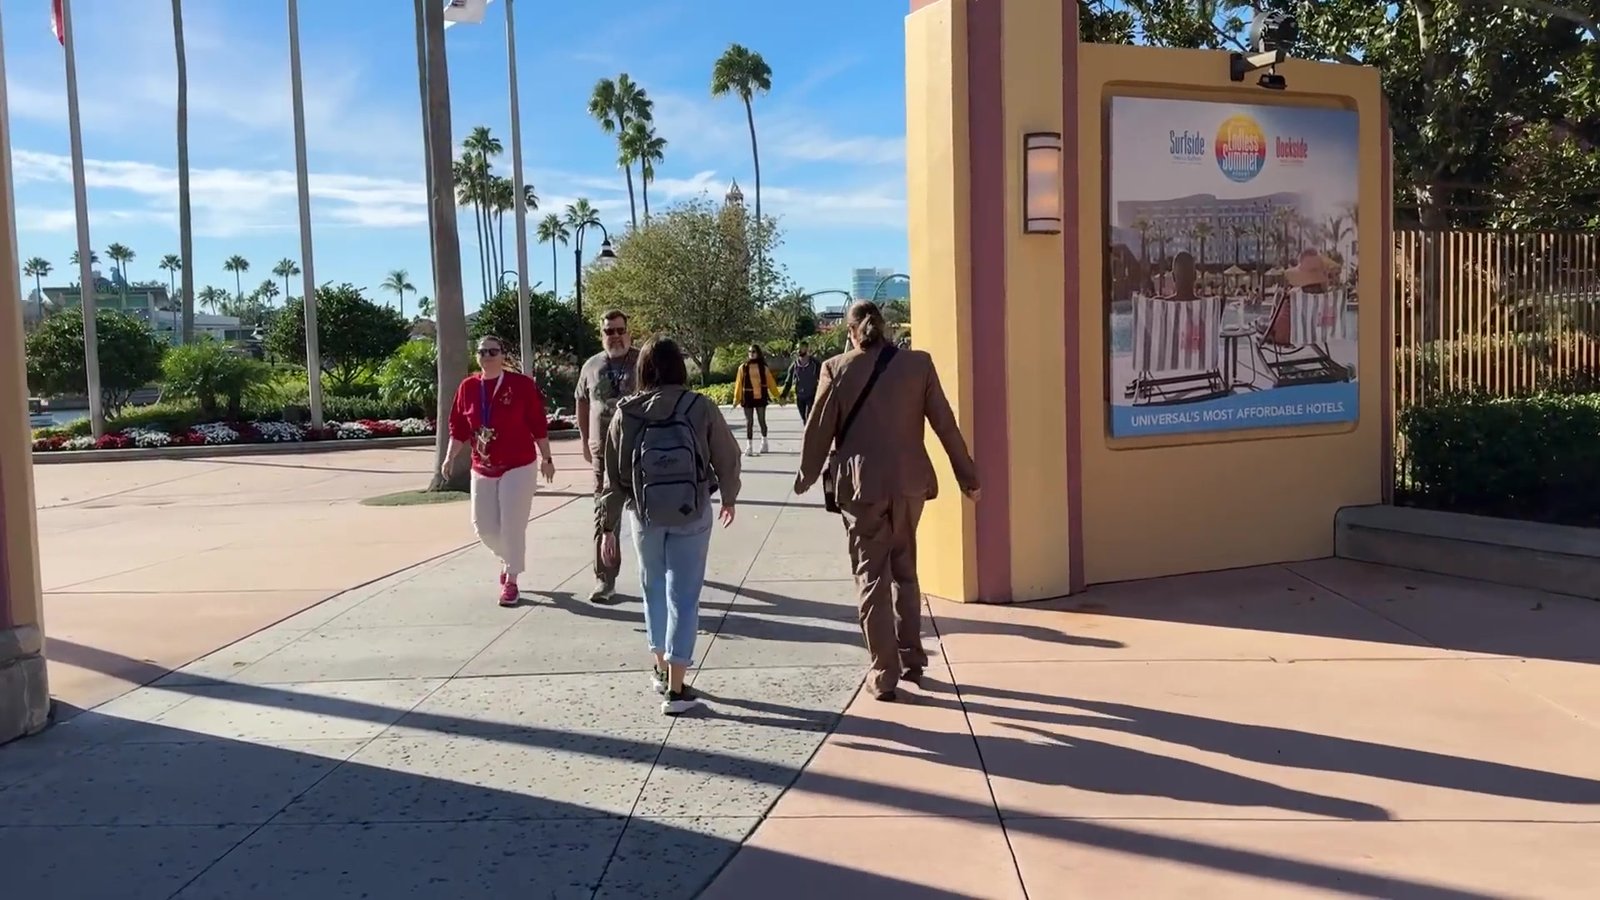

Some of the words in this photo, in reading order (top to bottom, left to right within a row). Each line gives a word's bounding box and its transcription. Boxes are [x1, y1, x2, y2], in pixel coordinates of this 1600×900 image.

[1169, 130, 1205, 155] Surfside
[1228, 126, 1259, 151] Endless
[1276, 136, 1308, 158] Dockside
[1222, 143, 1259, 171] Summer
[1131, 411, 1200, 427] UNIVERSAL'S
[1202, 409, 1234, 422] MOST
[1236, 404, 1303, 419] AFFORDABLE
